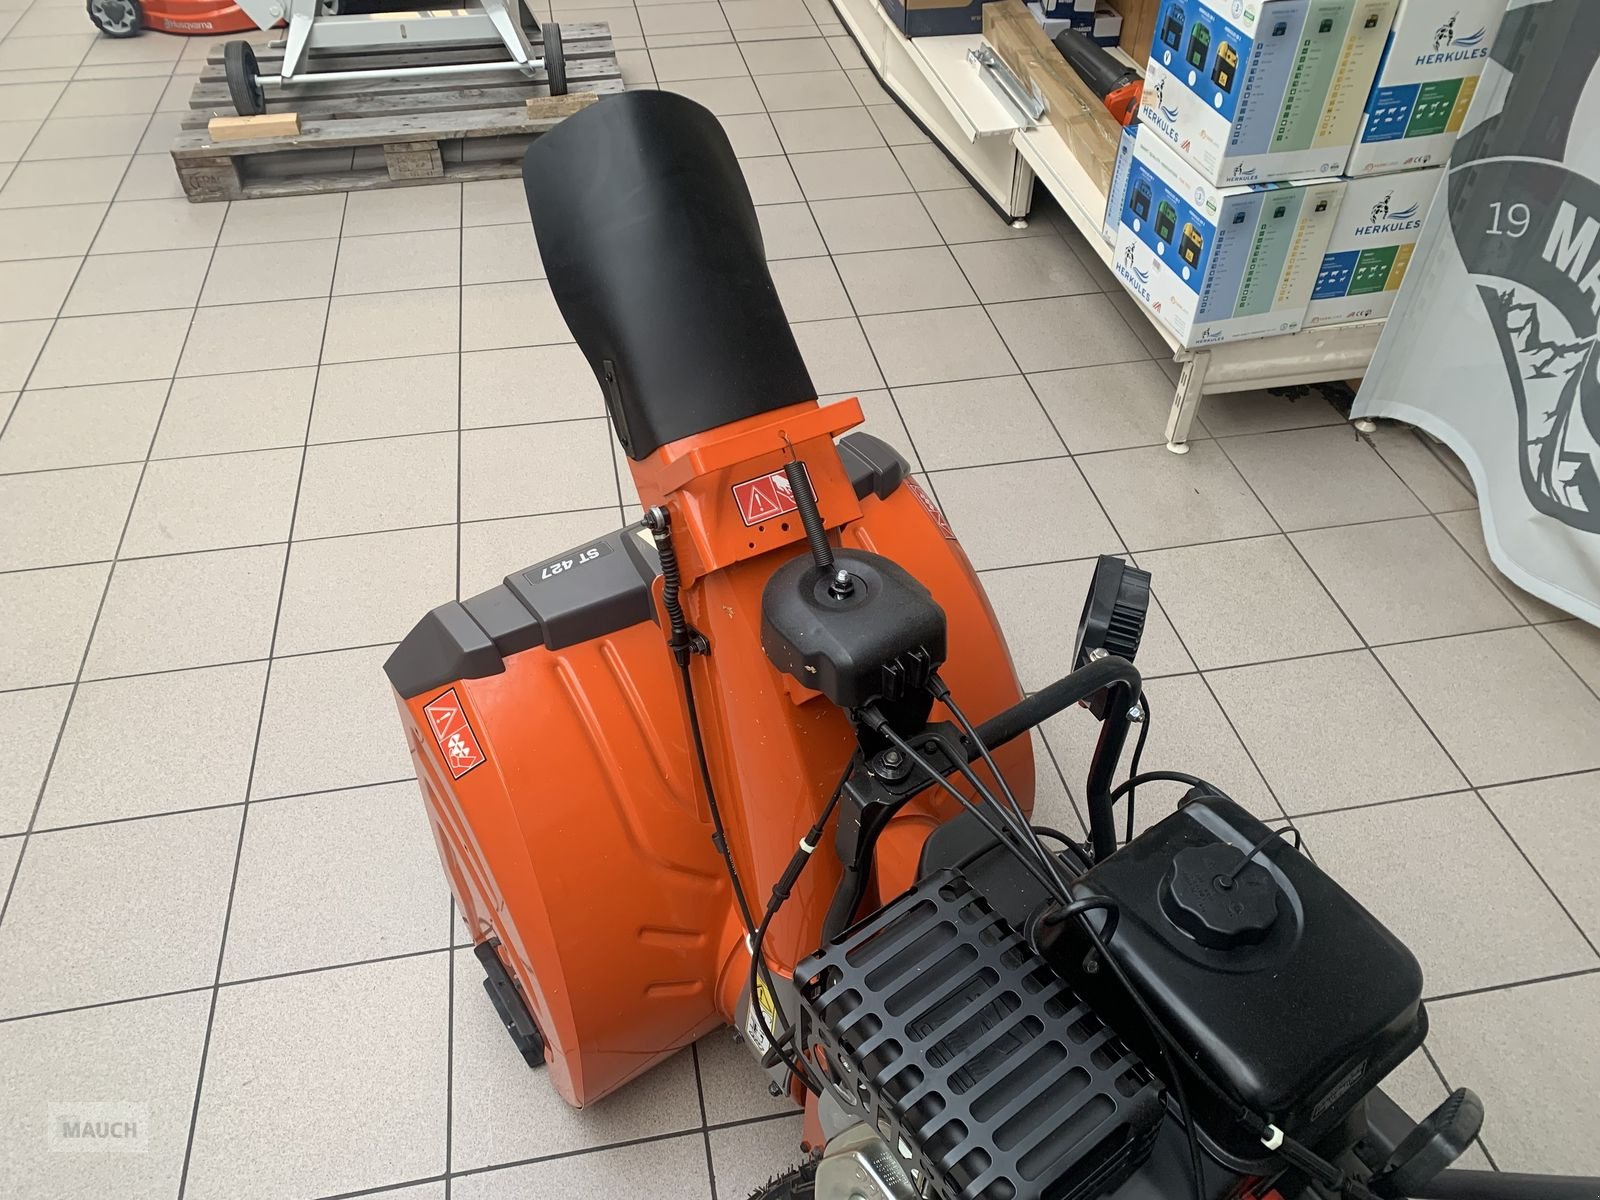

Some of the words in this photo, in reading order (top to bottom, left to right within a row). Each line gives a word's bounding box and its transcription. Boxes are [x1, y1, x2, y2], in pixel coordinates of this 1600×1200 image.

[1415, 47, 1488, 66] HERKULES
[1142, 105, 1179, 143] HERKULES
[1226, 174, 1258, 182] HERKULES
[1354, 219, 1421, 236] HERKULES
[1485, 201, 1531, 238] 19
[1115, 262, 1151, 303] HERKULES
[578, 548, 600, 564] ST
[541, 559, 573, 580] 427
